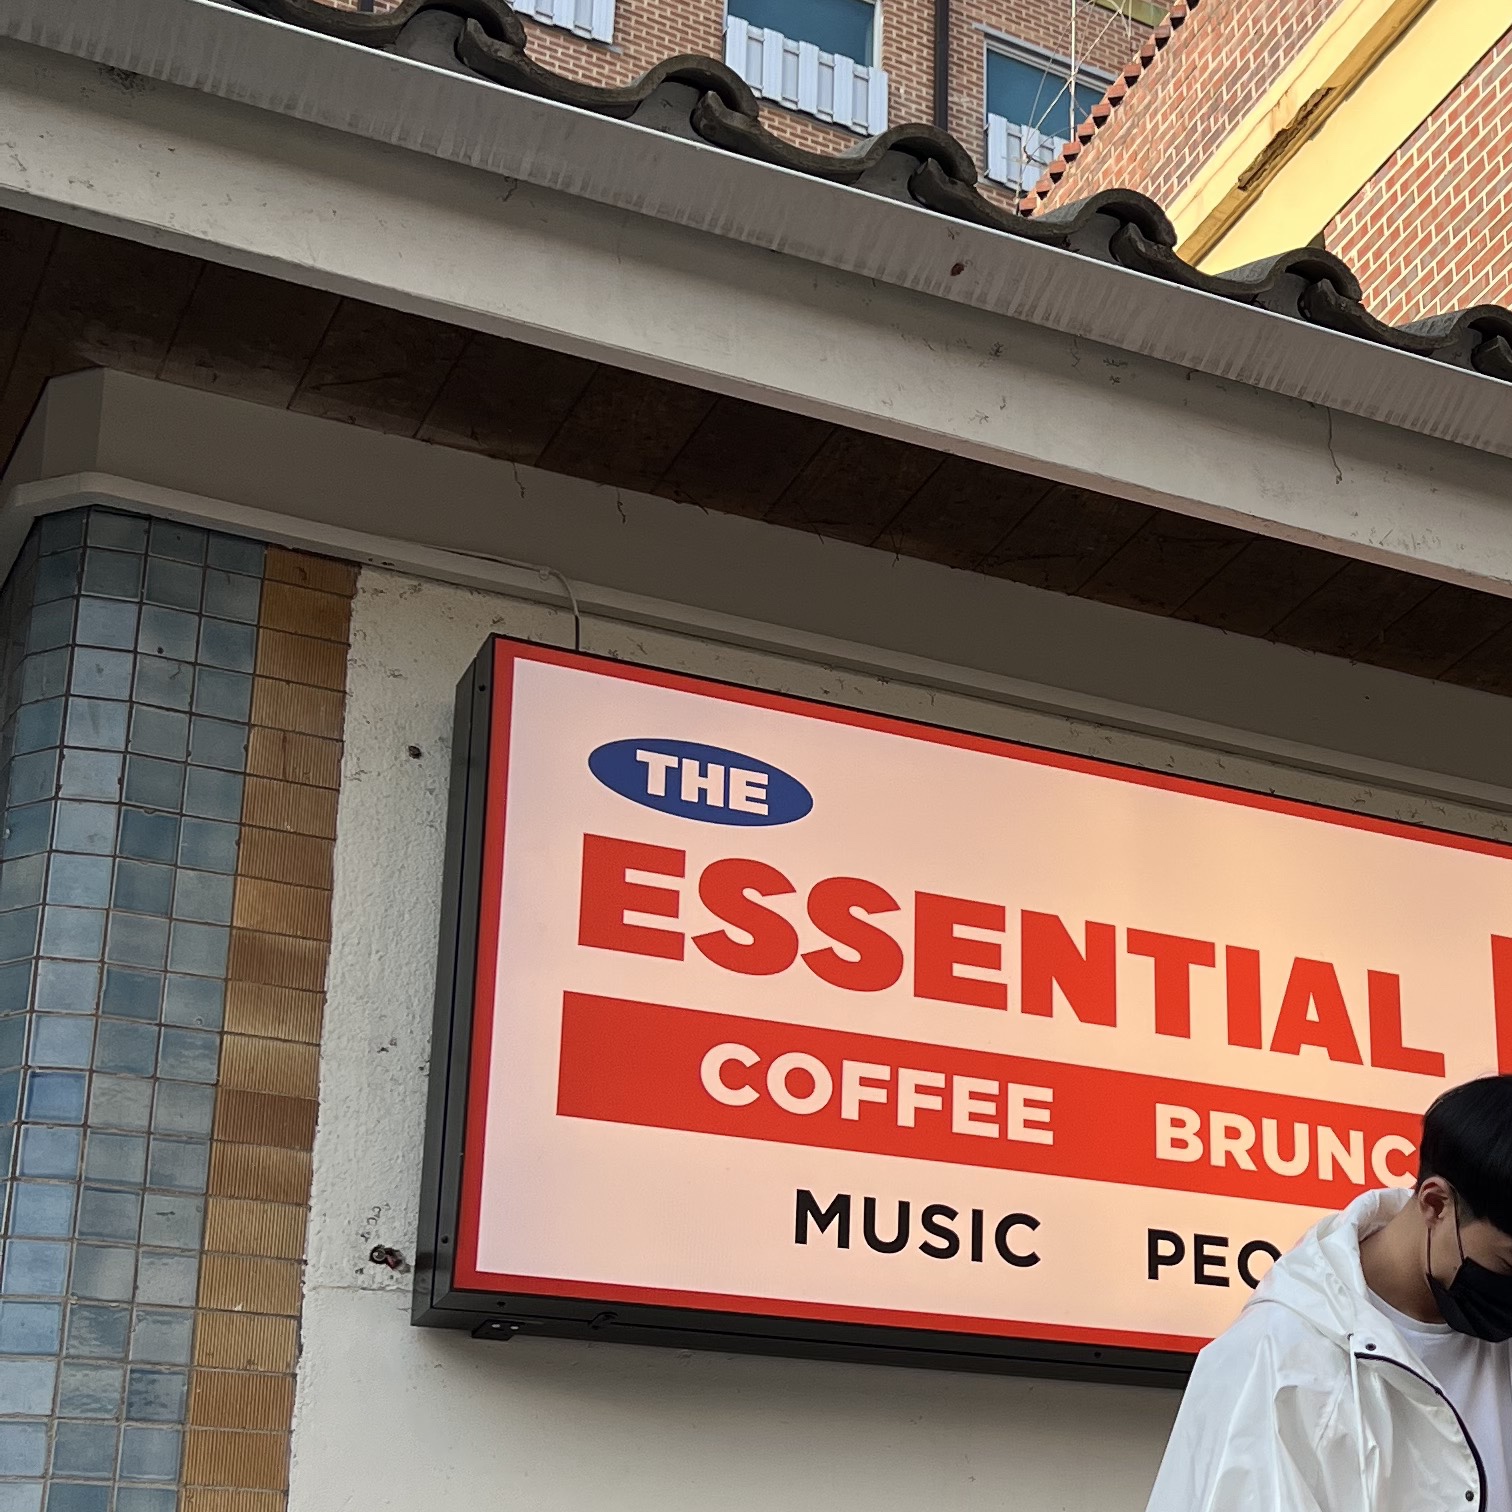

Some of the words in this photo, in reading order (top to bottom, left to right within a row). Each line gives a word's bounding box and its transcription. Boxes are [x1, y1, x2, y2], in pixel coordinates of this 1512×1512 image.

[637, 750, 769, 816] THE
[578, 833, 1446, 1078] ESSENTIAL
[700, 1043, 1054, 1145] COFFEE
[1155, 1103, 1418, 1189] BRUNC
[794, 1188, 1041, 1268] MUSIC
[1147, 1228, 1282, 1290] PEO
